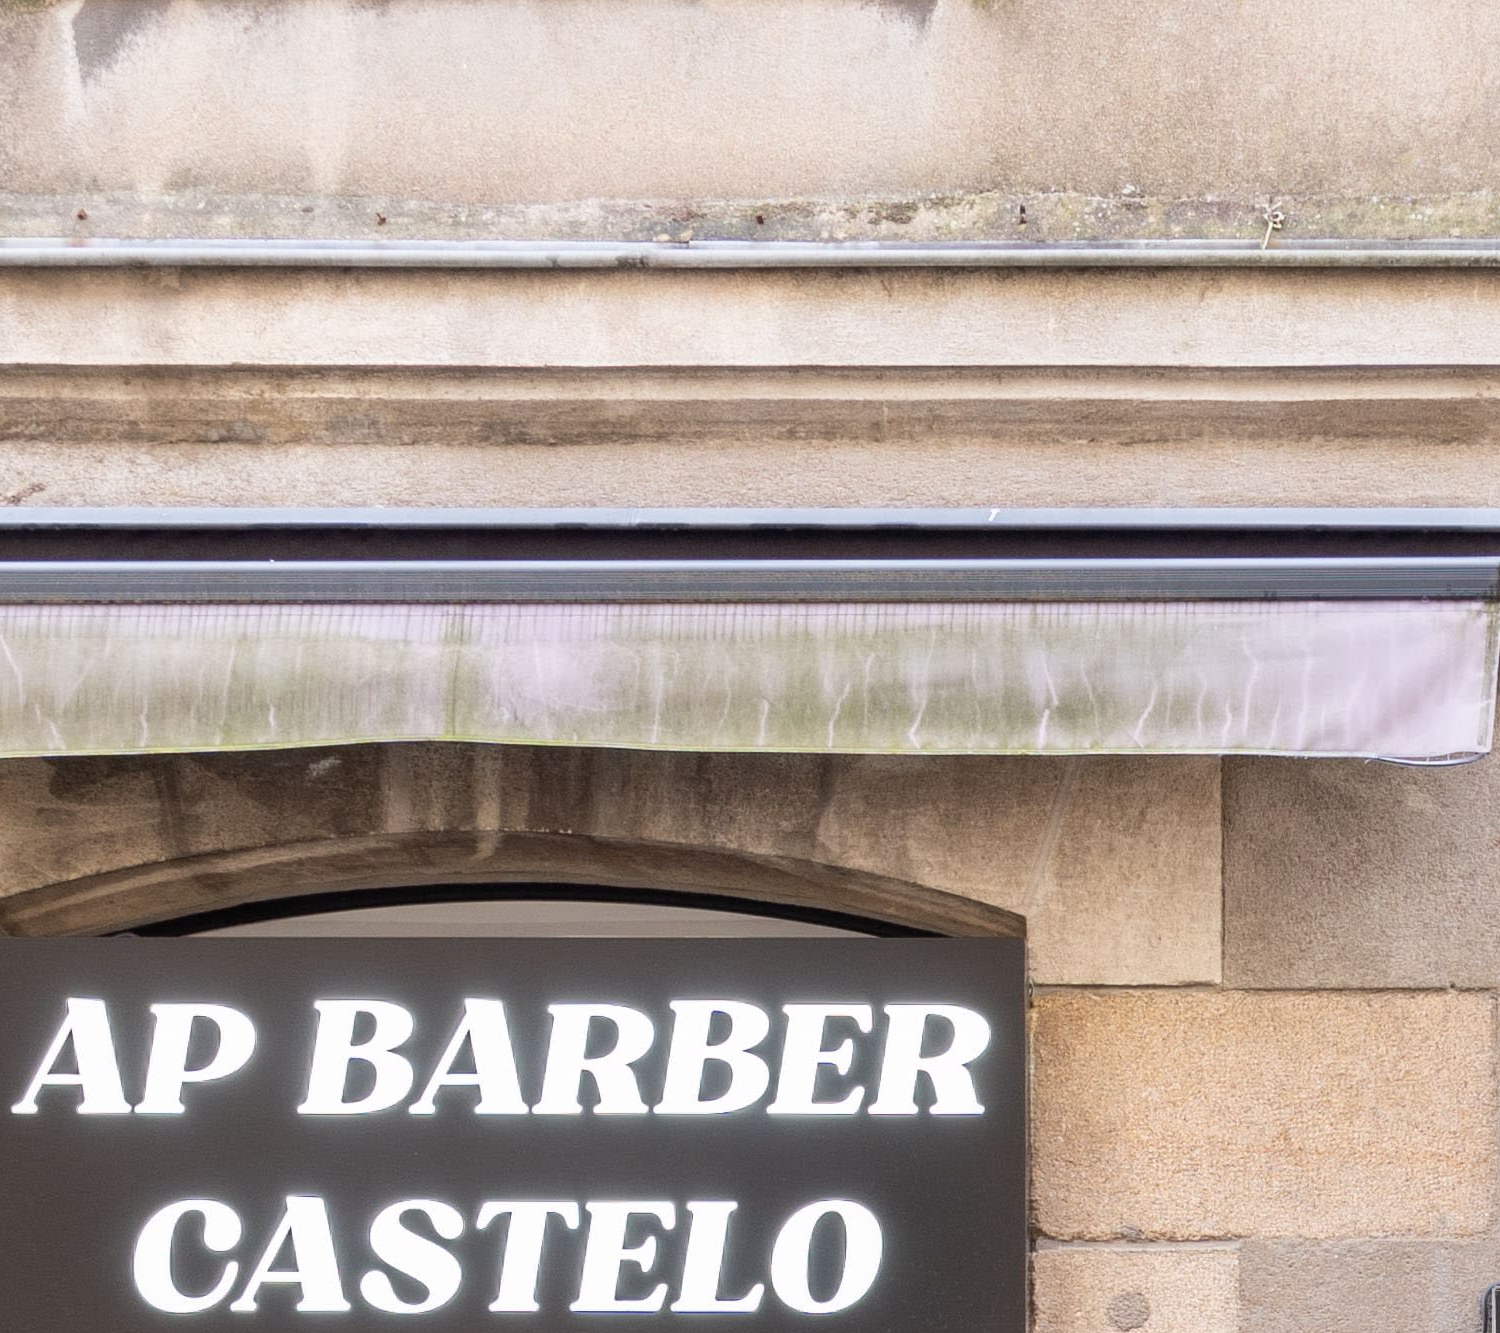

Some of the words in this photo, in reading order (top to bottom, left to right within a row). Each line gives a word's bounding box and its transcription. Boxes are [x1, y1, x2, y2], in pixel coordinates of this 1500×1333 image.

[12, 997, 257, 1115] AP
[297, 998, 992, 1115] BARBER
[133, 1196, 883, 1314] CASTELO
